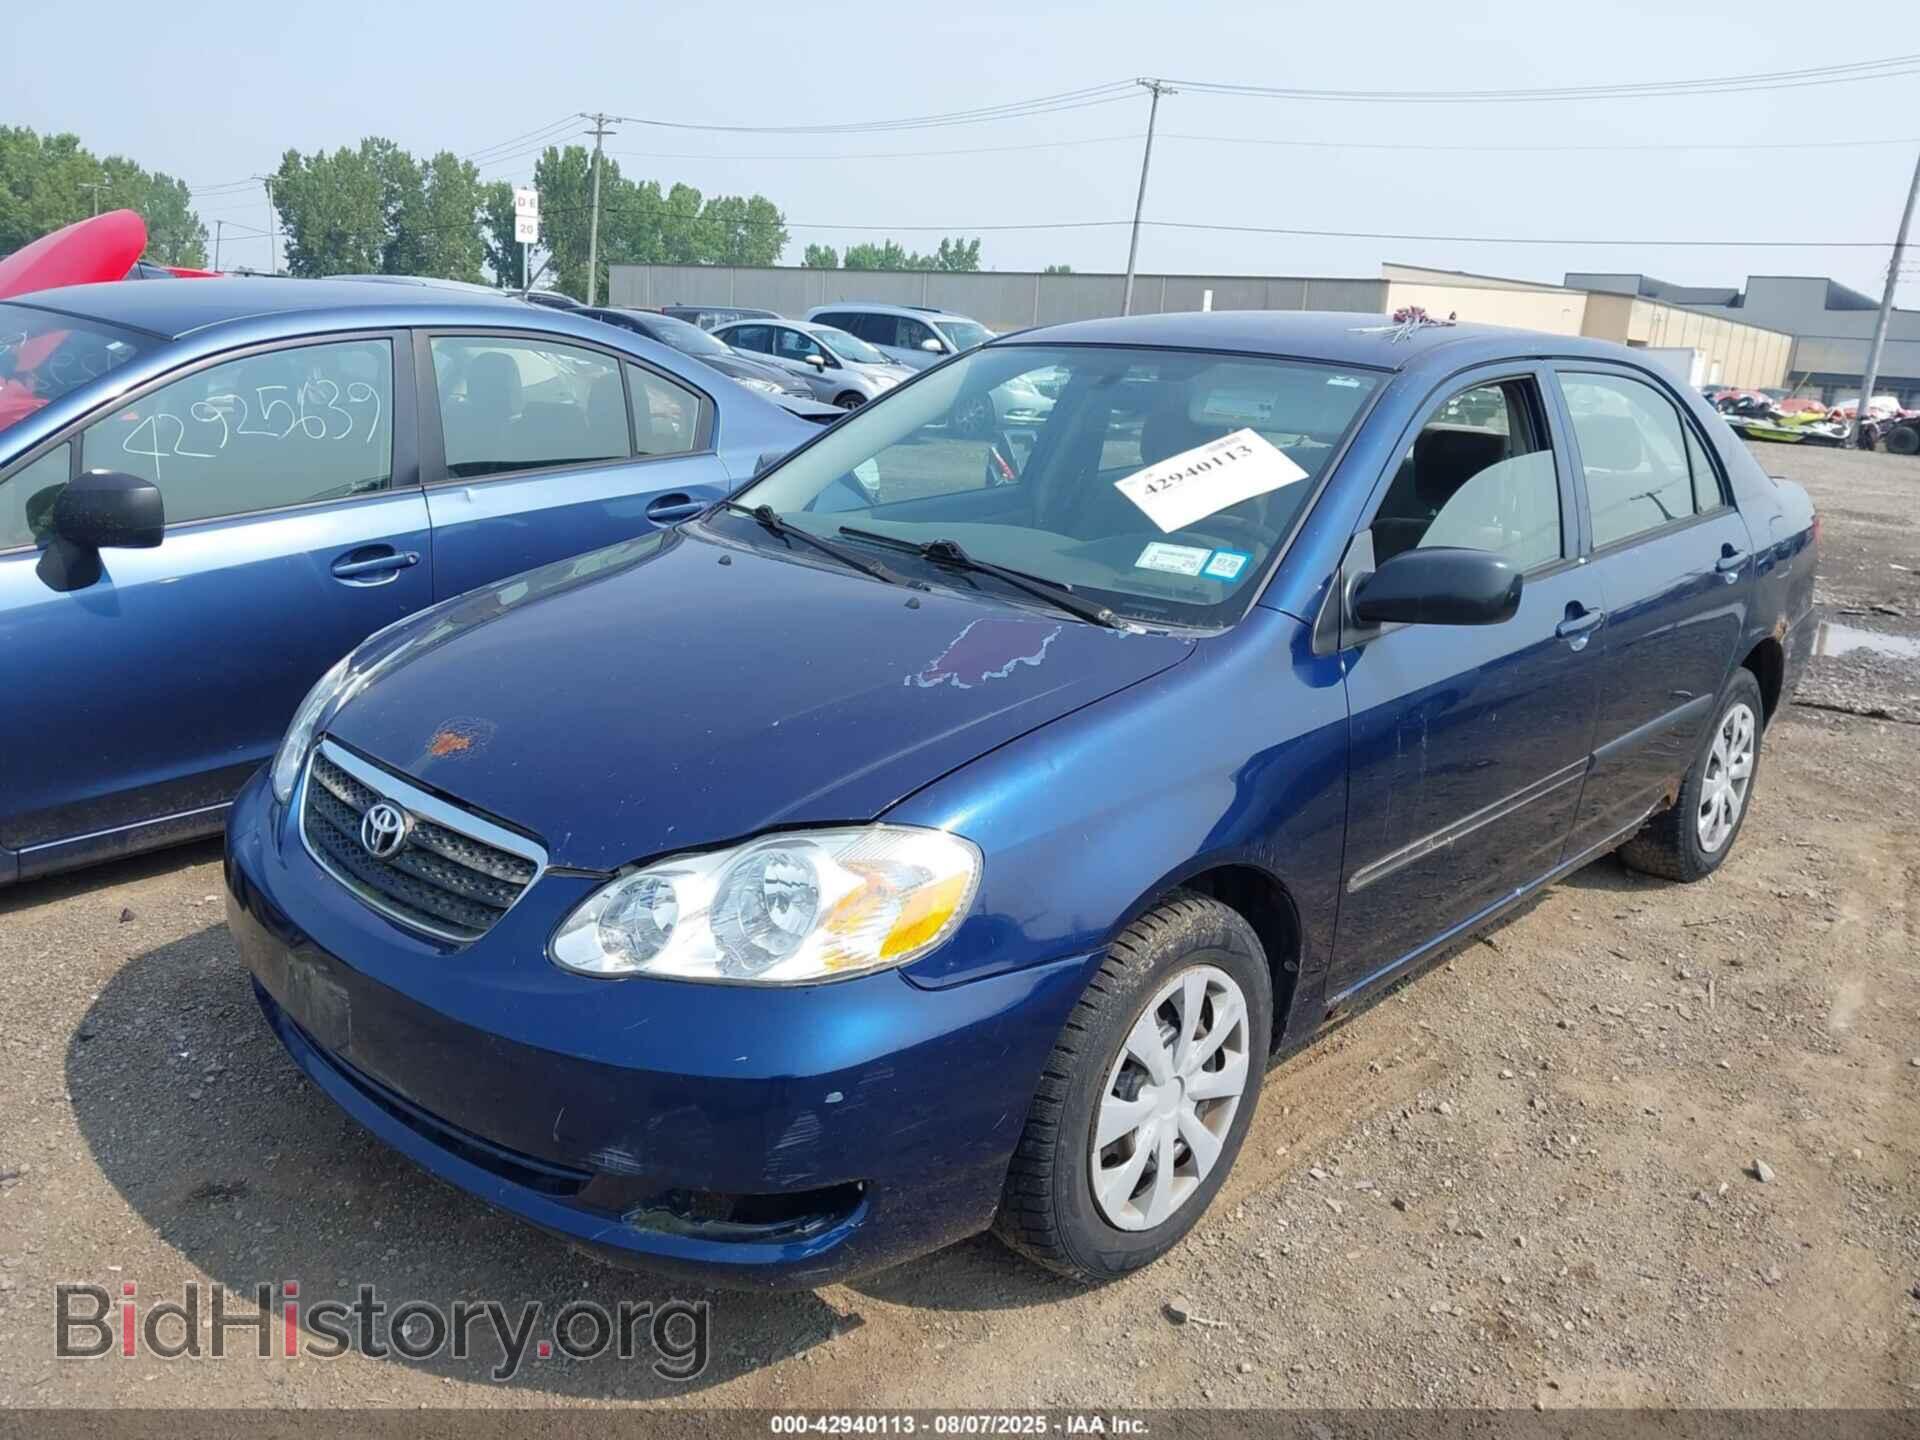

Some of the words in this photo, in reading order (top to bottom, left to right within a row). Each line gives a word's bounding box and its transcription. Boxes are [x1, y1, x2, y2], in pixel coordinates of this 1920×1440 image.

[520, 224, 533, 234] 20
[122, 379, 381, 480] 42925639
[1145, 444, 1253, 495] 42940113
